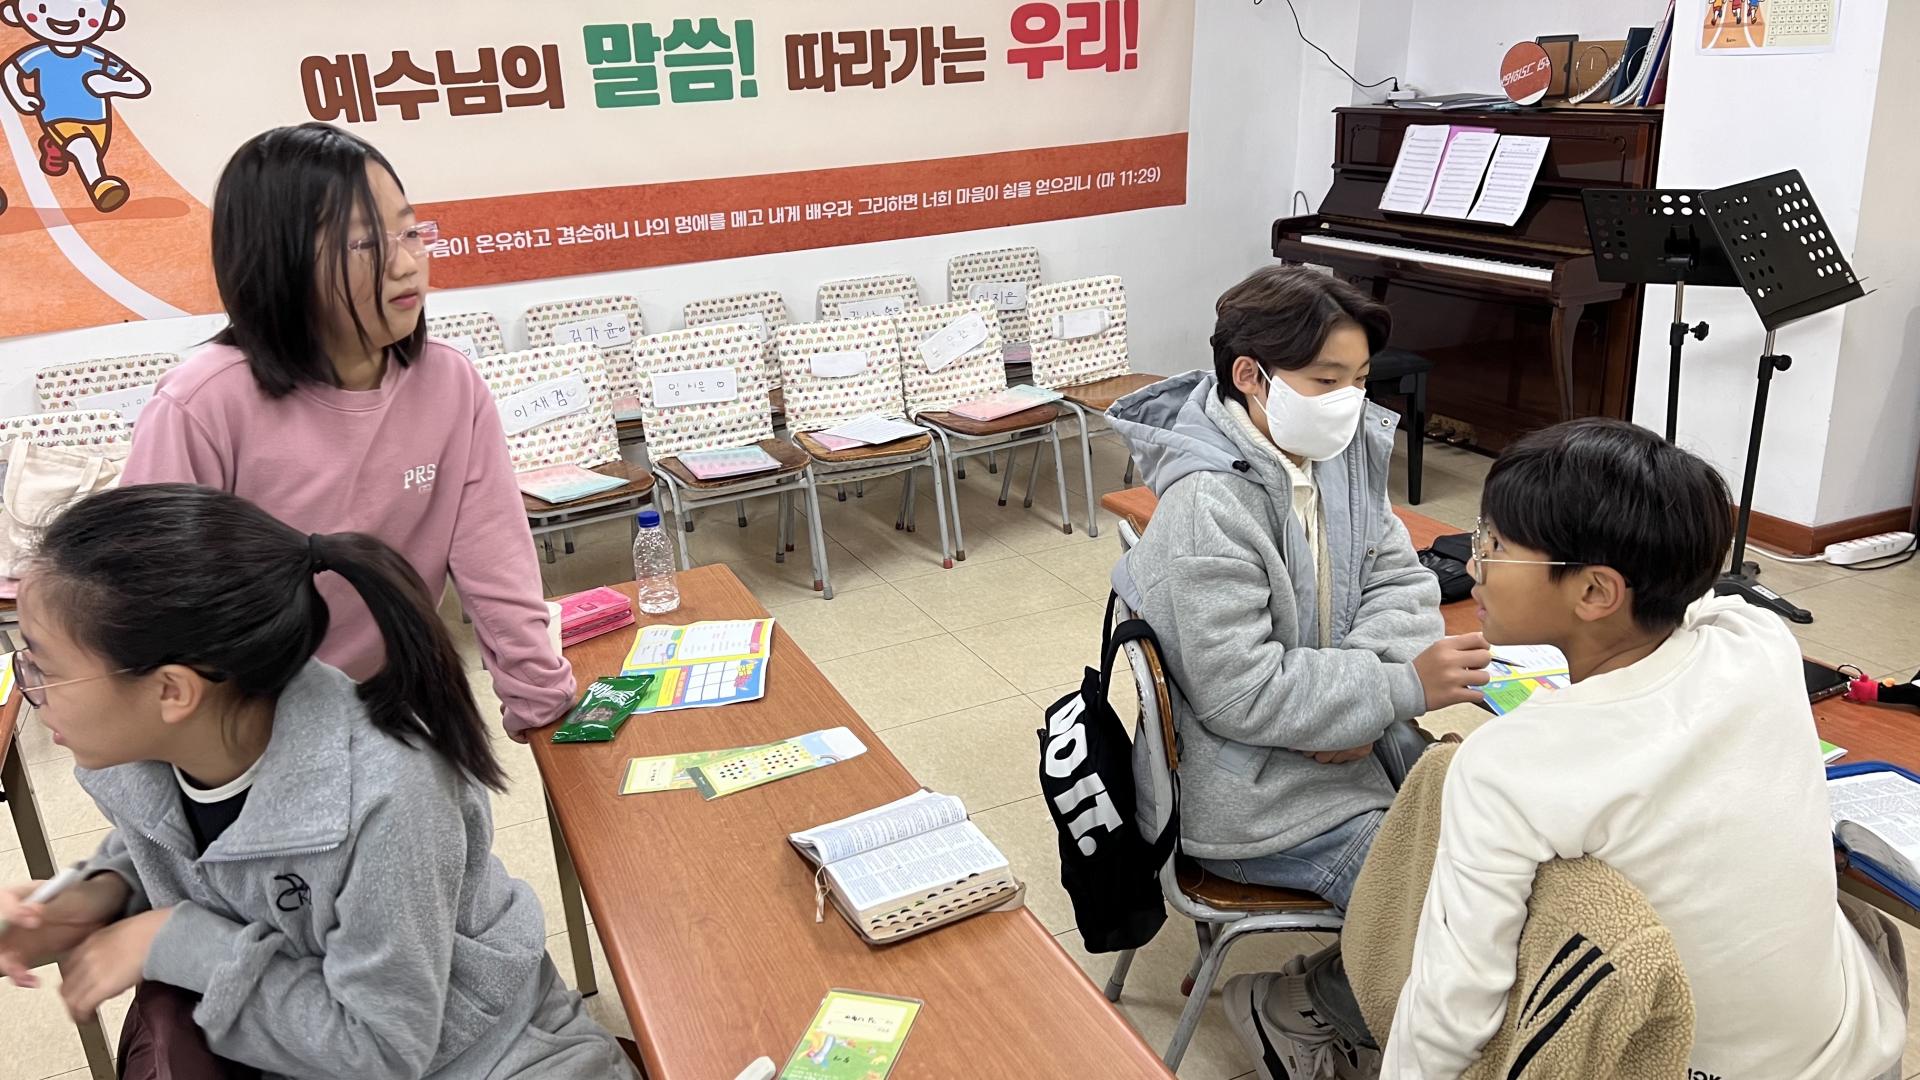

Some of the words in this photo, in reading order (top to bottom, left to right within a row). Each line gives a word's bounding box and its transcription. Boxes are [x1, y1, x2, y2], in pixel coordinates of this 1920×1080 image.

[300, 44, 565, 123] 예수님의
[583, 17, 758, 109] 말씀!
[785, 26, 986, 92] 따라가는
[1007, 0, 1139, 80] 우리!
[426, 236, 470, 258] 음이
[475, 228, 553, 255] 온유하고
[555, 221, 630, 246] 겸손하니
[633, 216, 670, 238] 나의
[674, 211, 727, 234] 멍에를
[730, 208, 764, 228] 메고
[767, 204, 801, 224] 내게
[805, 199, 854, 221] 배우라
[857, 192, 919, 216] 그리하면
[922, 189, 952, 208] 너희
[956, 184, 999, 205] 마음이
[1002, 180, 1032, 200] 쉼을
[1035, 174, 1092, 196] 얻으리니
[1095, 171, 1116, 190] (마
[1119, 166, 1162, 187] 11:29)
[403, 463, 436, 489] PRS
